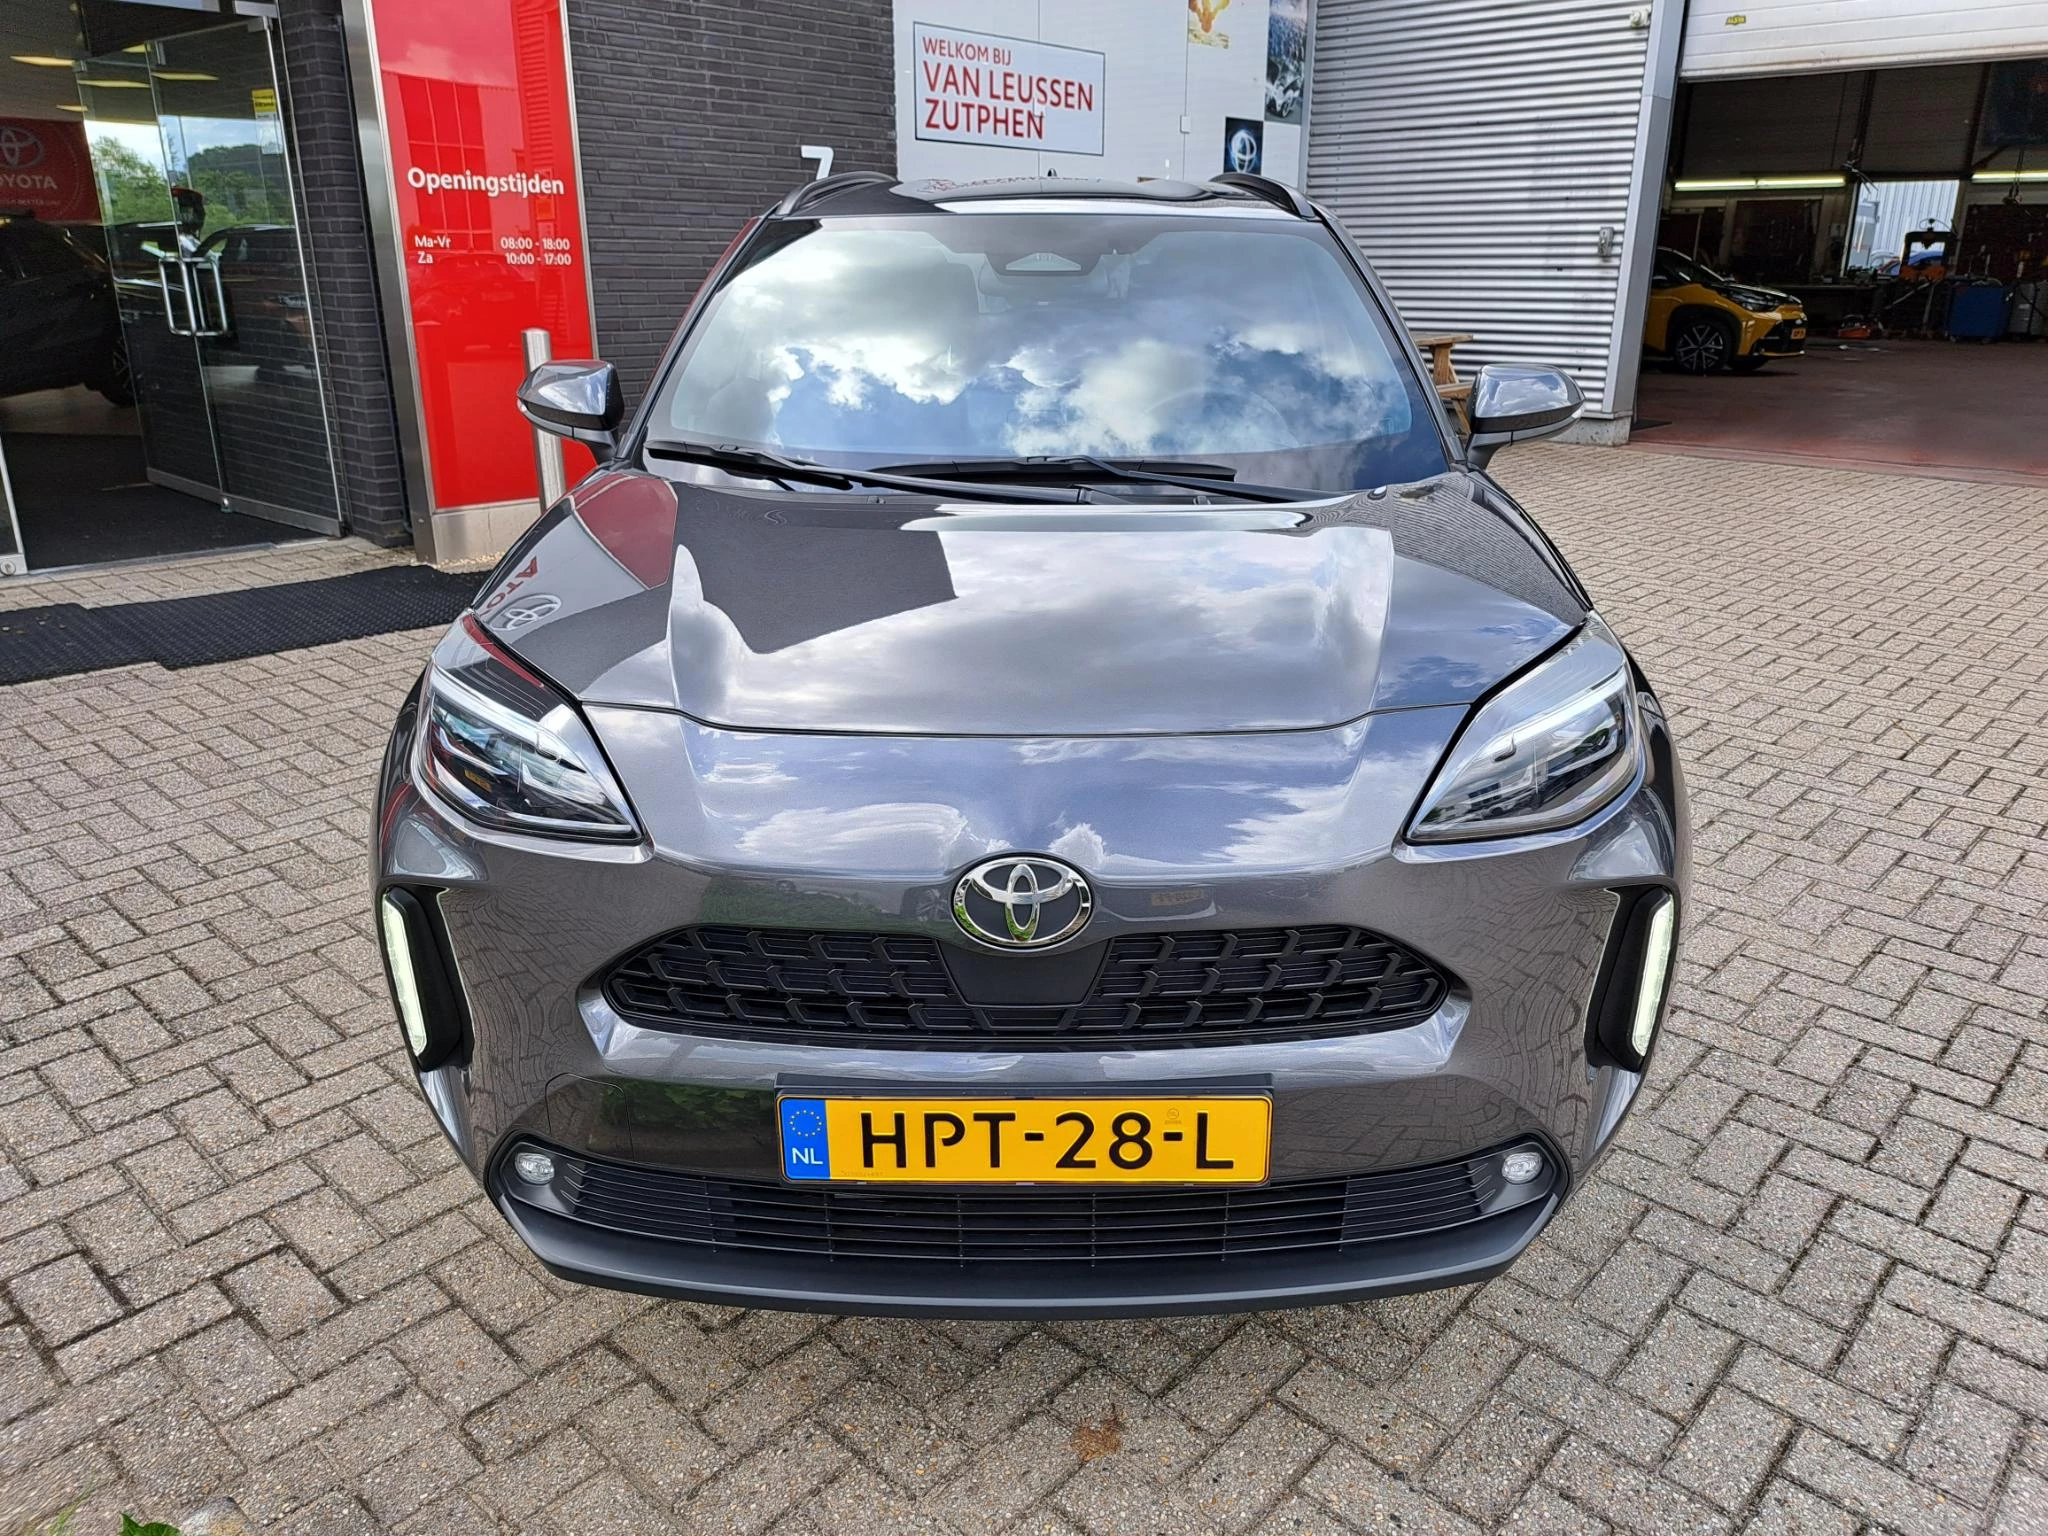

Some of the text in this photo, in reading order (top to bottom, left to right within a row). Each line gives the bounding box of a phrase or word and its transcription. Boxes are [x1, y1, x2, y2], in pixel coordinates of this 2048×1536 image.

[922, 36, 1012, 66] WELKOM BIJ
[923, 60, 1093, 111] VAN LEUSSEN
[925, 98, 1044, 140] ZUTPHEN
[801, 144, 834, 181] 7
[408, 167, 564, 197] Openingstijden
[414, 235, 451, 248] Ma-Vr
[500, 237, 533, 250] 08:00
[542, 238, 570, 250] 18:00
[417, 251, 434, 264] Za
[505, 253, 534, 265] 10:00
[544, 253, 572, 265] 17:00
[861, 1111, 1235, 1169] HPT-28-L
[791, 1147, 824, 1165] NL
